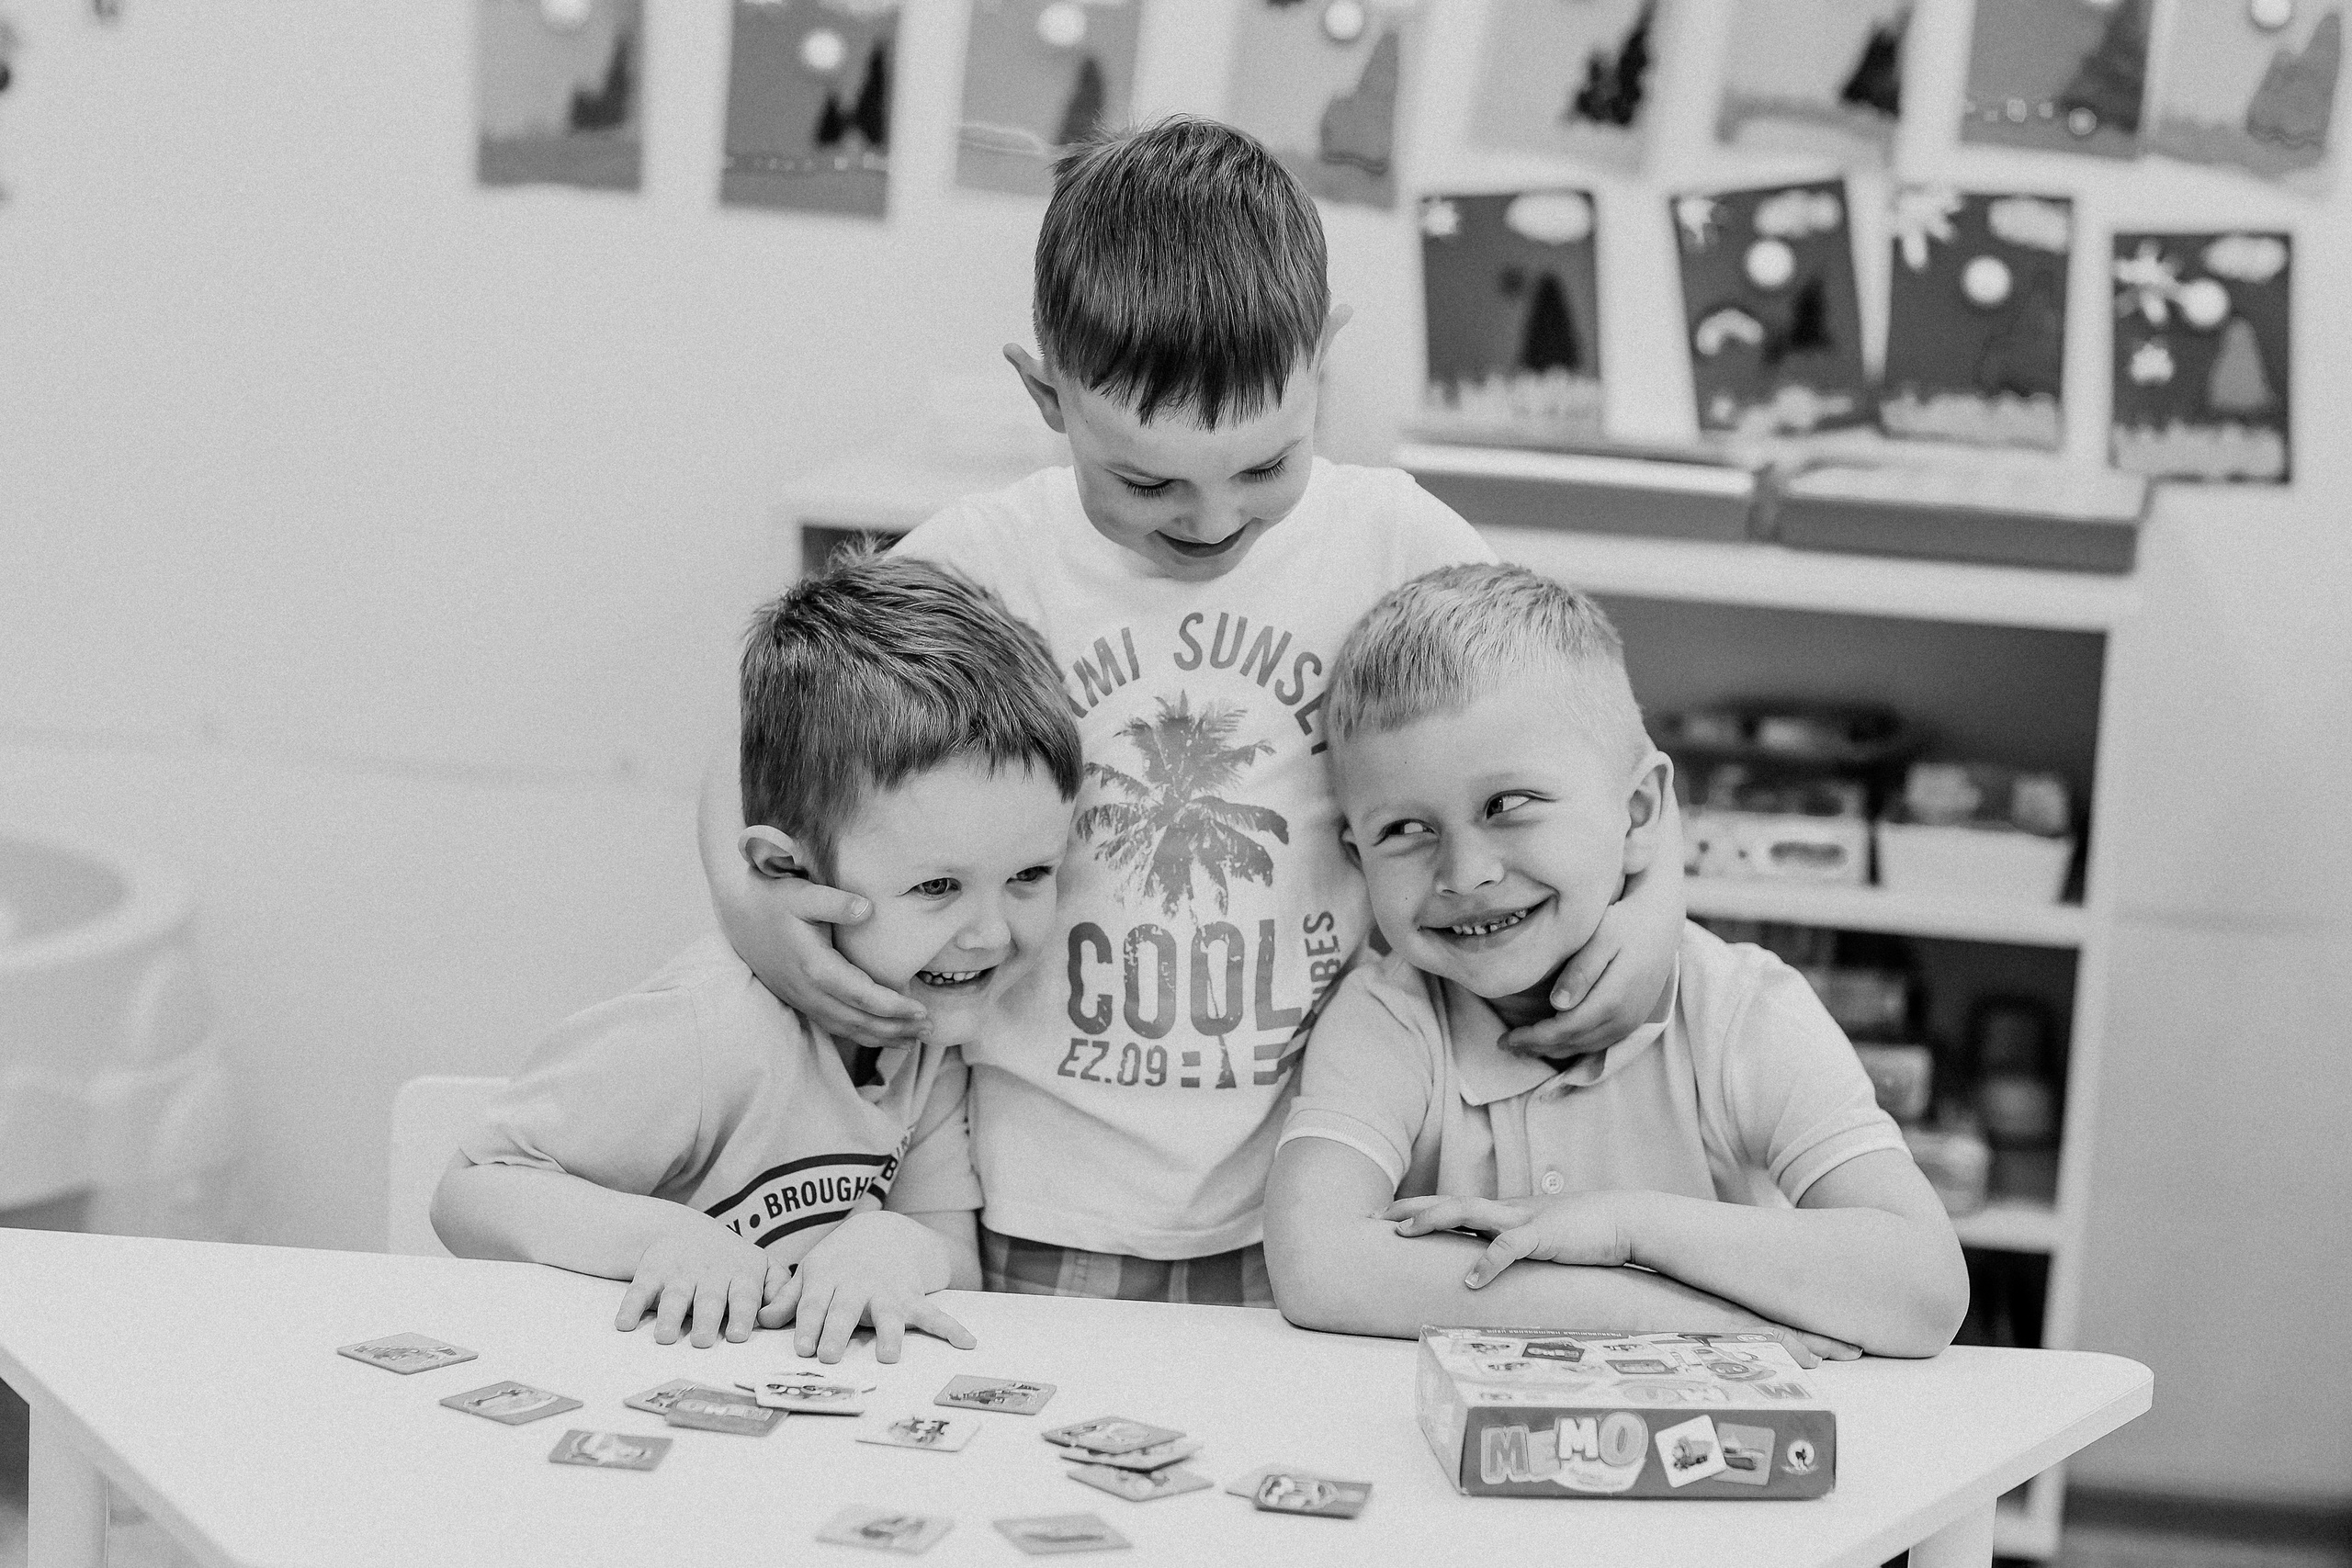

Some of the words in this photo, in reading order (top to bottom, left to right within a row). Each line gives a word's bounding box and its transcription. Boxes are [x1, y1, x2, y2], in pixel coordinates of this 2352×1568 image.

[1068, 919, 1302, 1040] COOL
[1303, 911, 1341, 1009] BES
[763, 1176, 876, 1220] BROUGH
